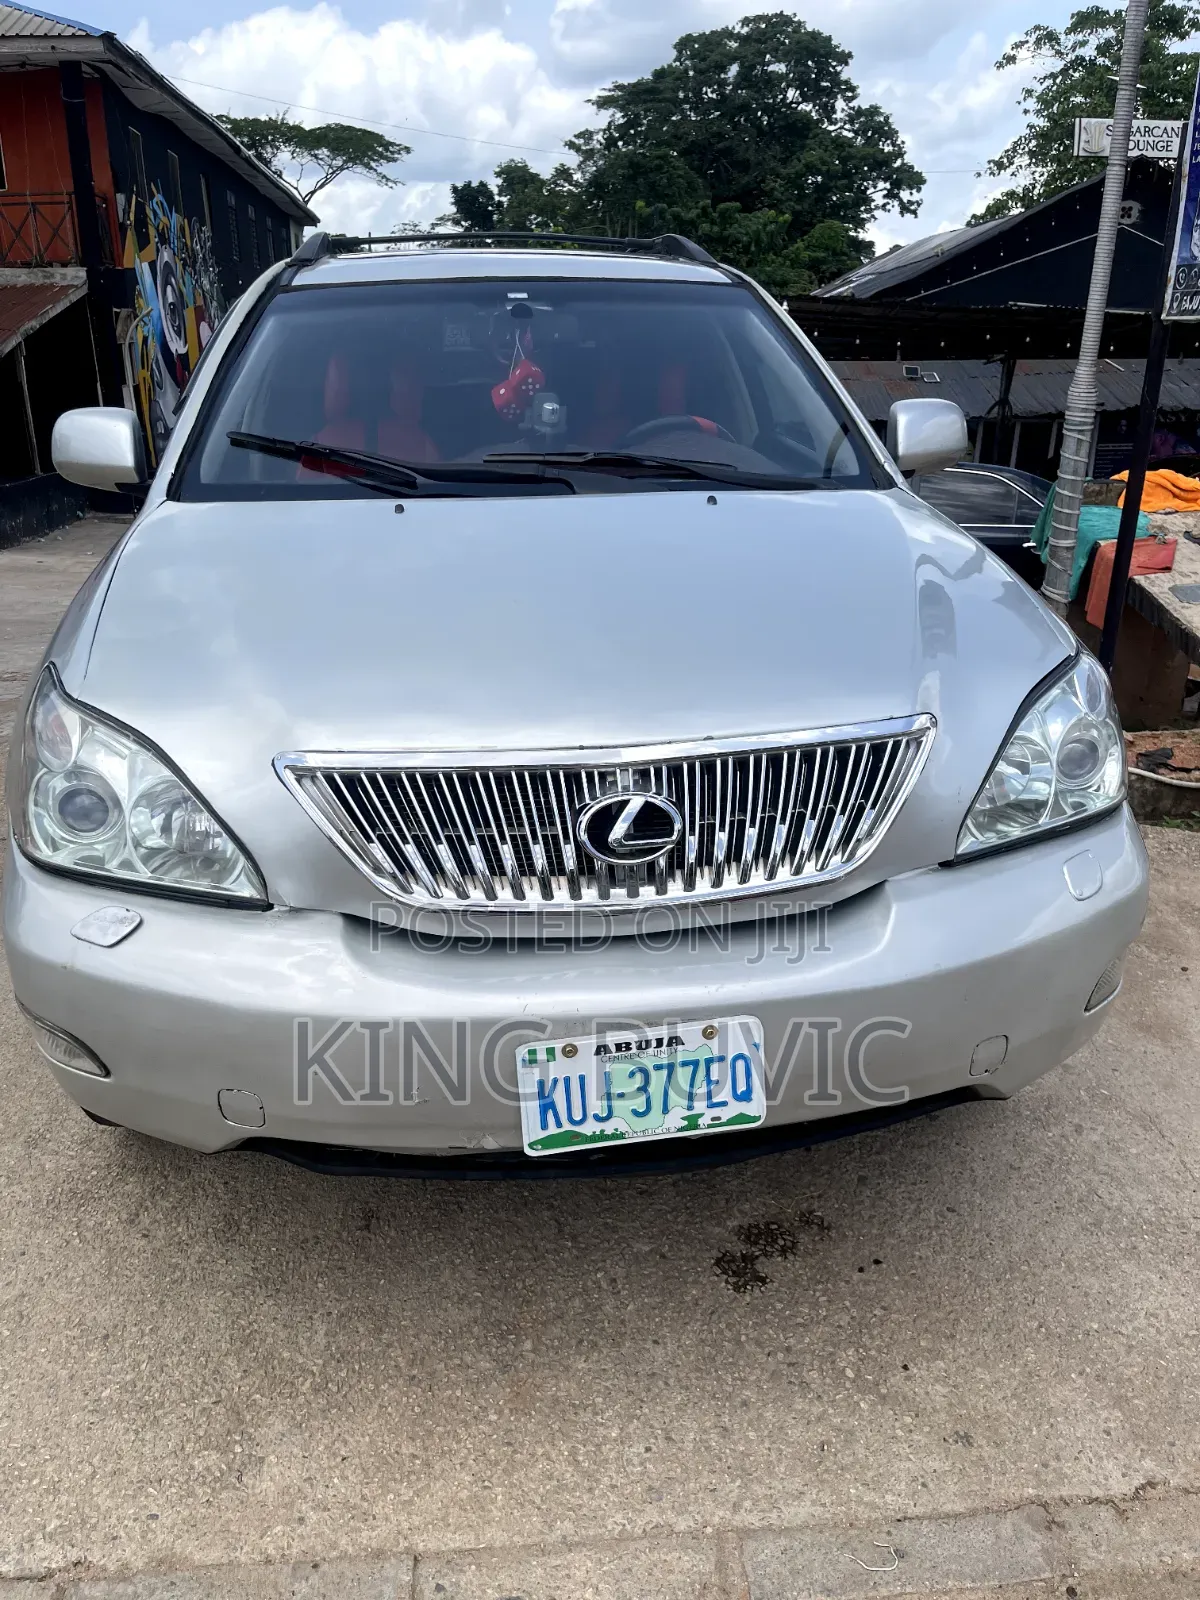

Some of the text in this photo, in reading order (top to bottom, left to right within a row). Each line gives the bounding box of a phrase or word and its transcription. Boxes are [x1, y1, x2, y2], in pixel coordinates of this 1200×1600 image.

[1106, 125, 1180, 138] SARCAN
[1128, 140, 1173, 152] OUNGE
[594, 1036, 685, 1056] ABUJA
[601, 1047, 679, 1063] CENTRE OF UNITY
[537, 1053, 753, 1131] KUJ-377EQ
